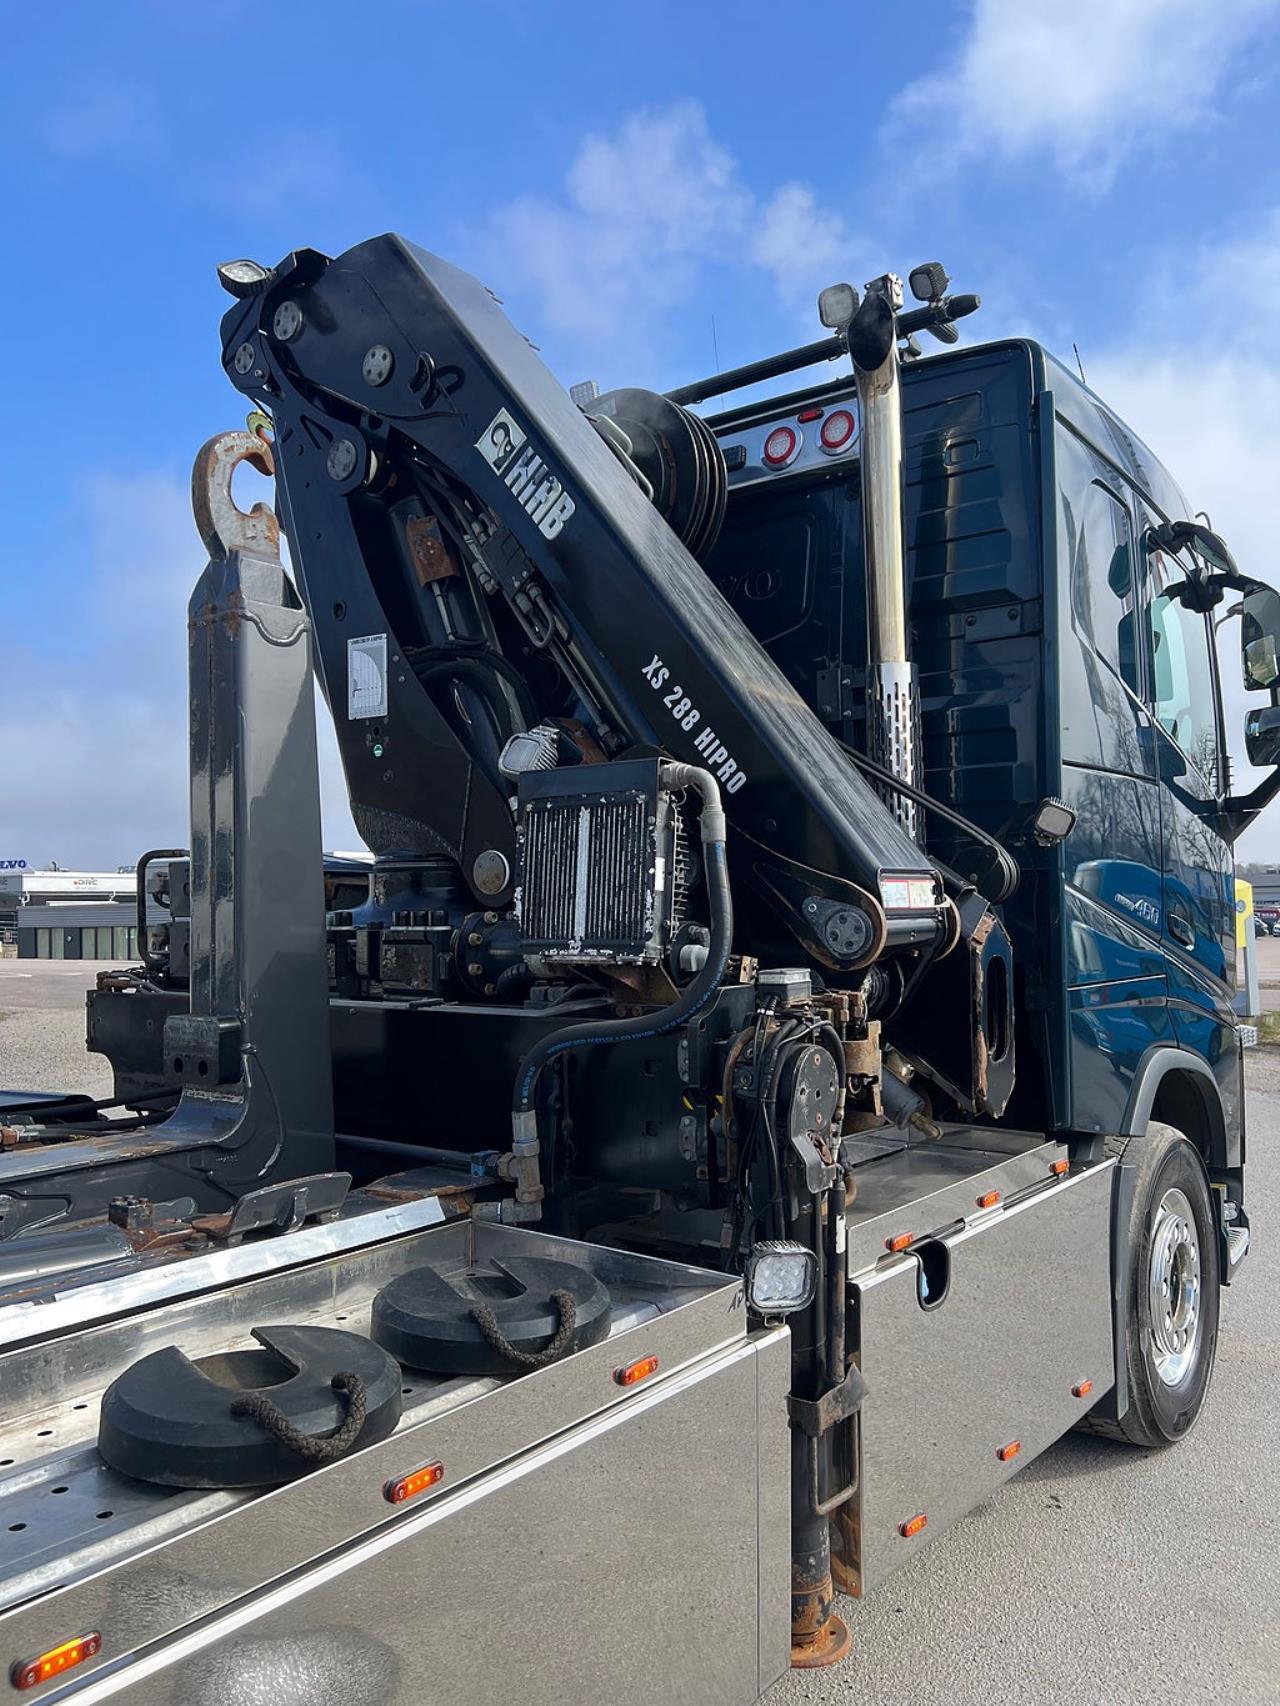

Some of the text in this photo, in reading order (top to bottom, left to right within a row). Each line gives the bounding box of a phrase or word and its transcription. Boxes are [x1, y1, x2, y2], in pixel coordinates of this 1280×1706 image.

[504, 446, 576, 540] HIAB
[641, 654, 747, 794] XS 288 HIPRO
